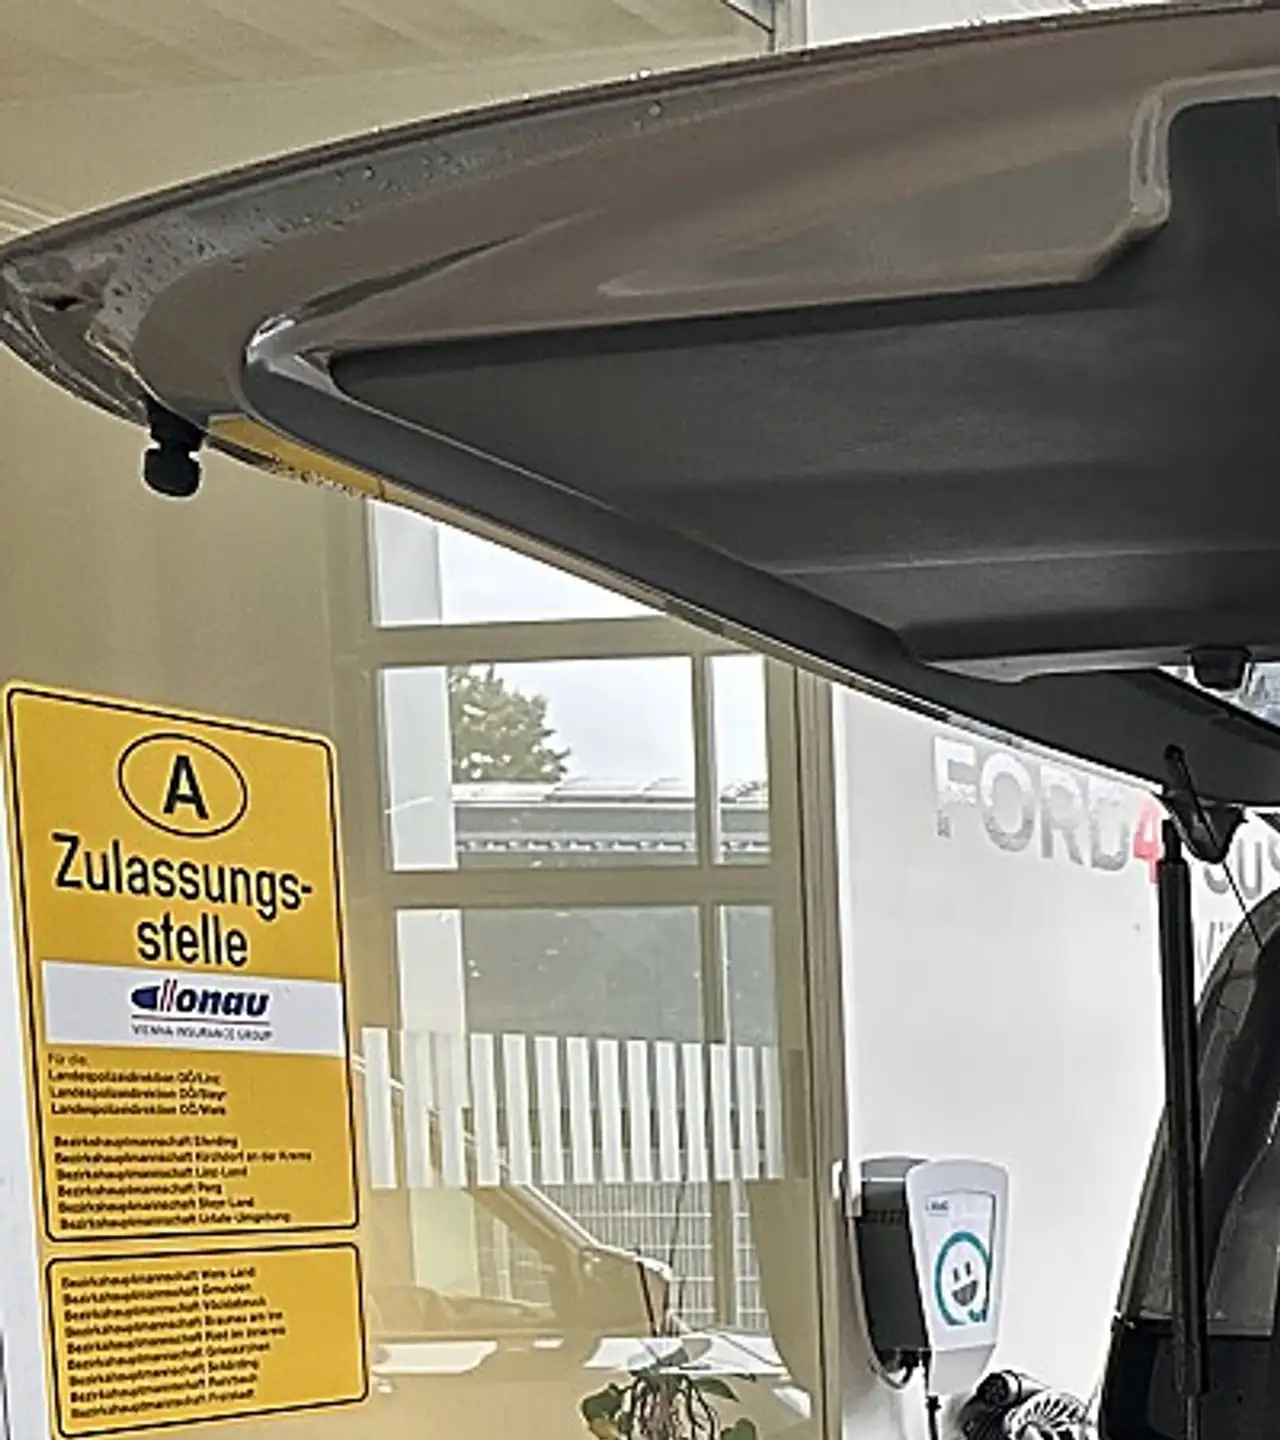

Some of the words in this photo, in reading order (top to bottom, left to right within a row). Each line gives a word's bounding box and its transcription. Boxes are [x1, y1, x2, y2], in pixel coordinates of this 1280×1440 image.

[163, 755, 209, 820] A
[51, 832, 313, 921] Zulassungs-
[137, 912, 248, 967] stelle
